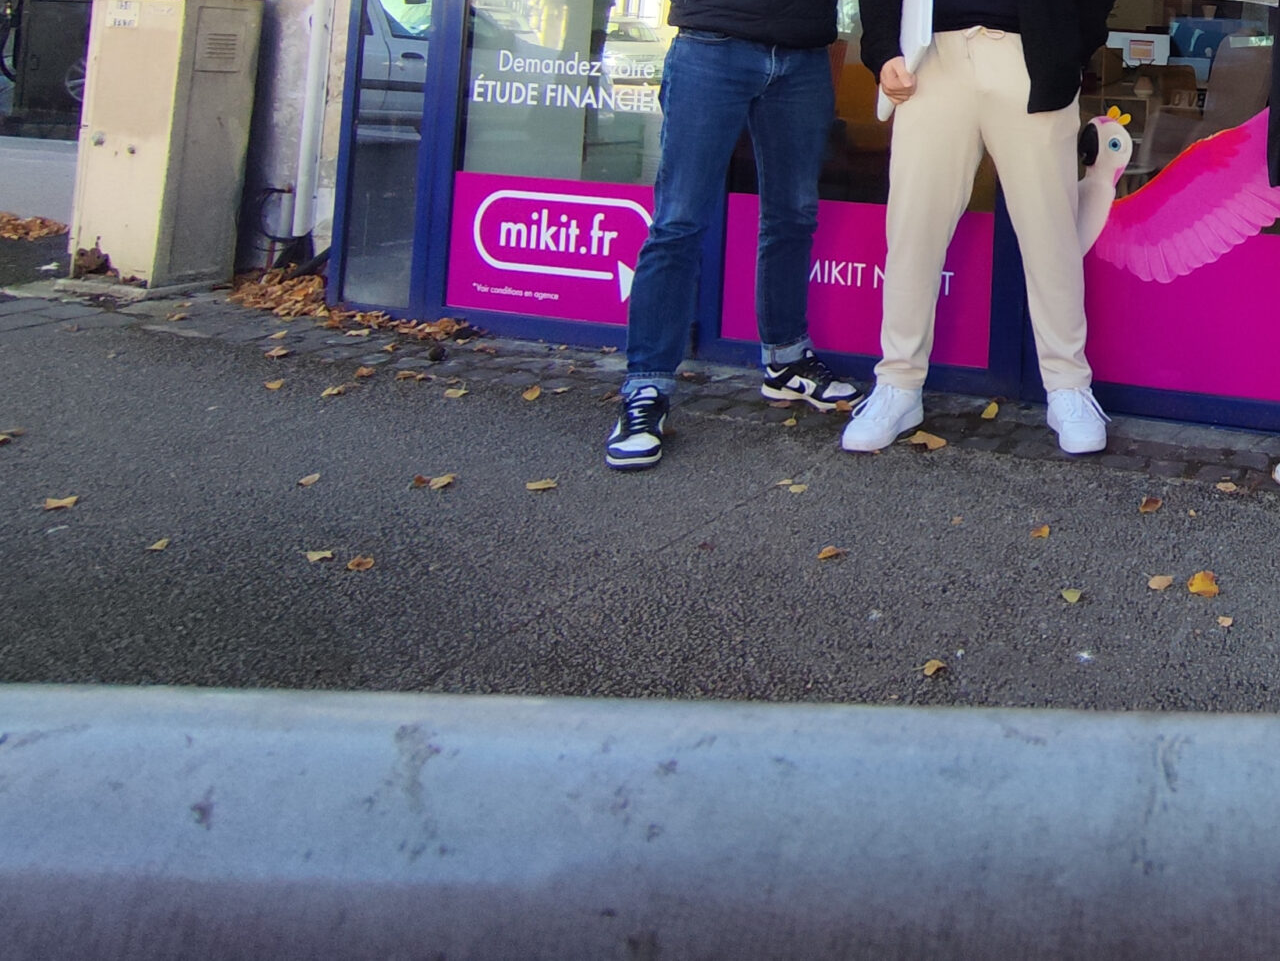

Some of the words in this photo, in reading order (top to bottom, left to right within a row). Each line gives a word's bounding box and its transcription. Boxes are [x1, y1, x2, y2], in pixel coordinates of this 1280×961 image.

[499, 50, 601, 76] Demandez
[471, 73, 540, 106] ÉTUDE
[499, 208, 619, 256] mikit.fr
